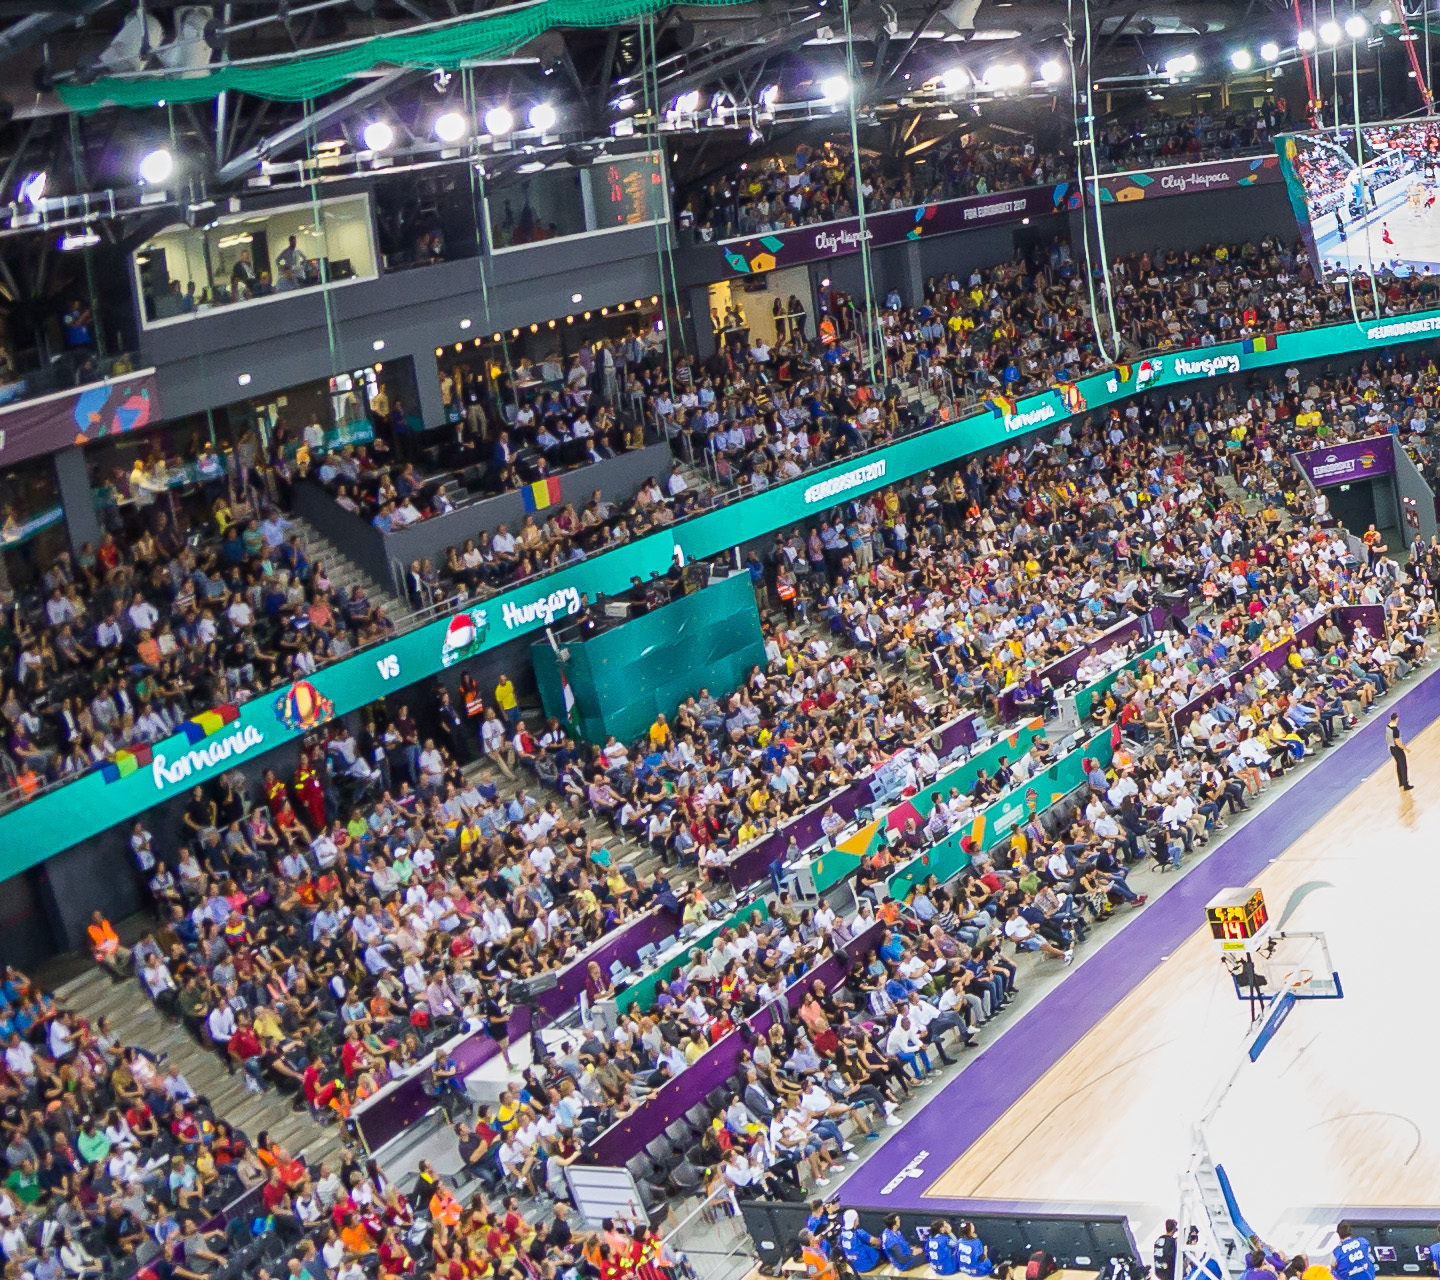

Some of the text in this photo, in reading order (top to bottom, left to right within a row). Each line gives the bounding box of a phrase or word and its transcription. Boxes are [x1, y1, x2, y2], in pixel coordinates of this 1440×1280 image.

[1161, 172, 1229, 190] Cluj-Napoca
[1175, 355, 1239, 377] Hungary
[804, 459, 885, 504] #EUROBASKET2017
[502, 587, 581, 630] Hungary
[376, 654, 400, 680] VS
[152, 721, 263, 789] Romania
[1224, 922, 1246, 938] 14
